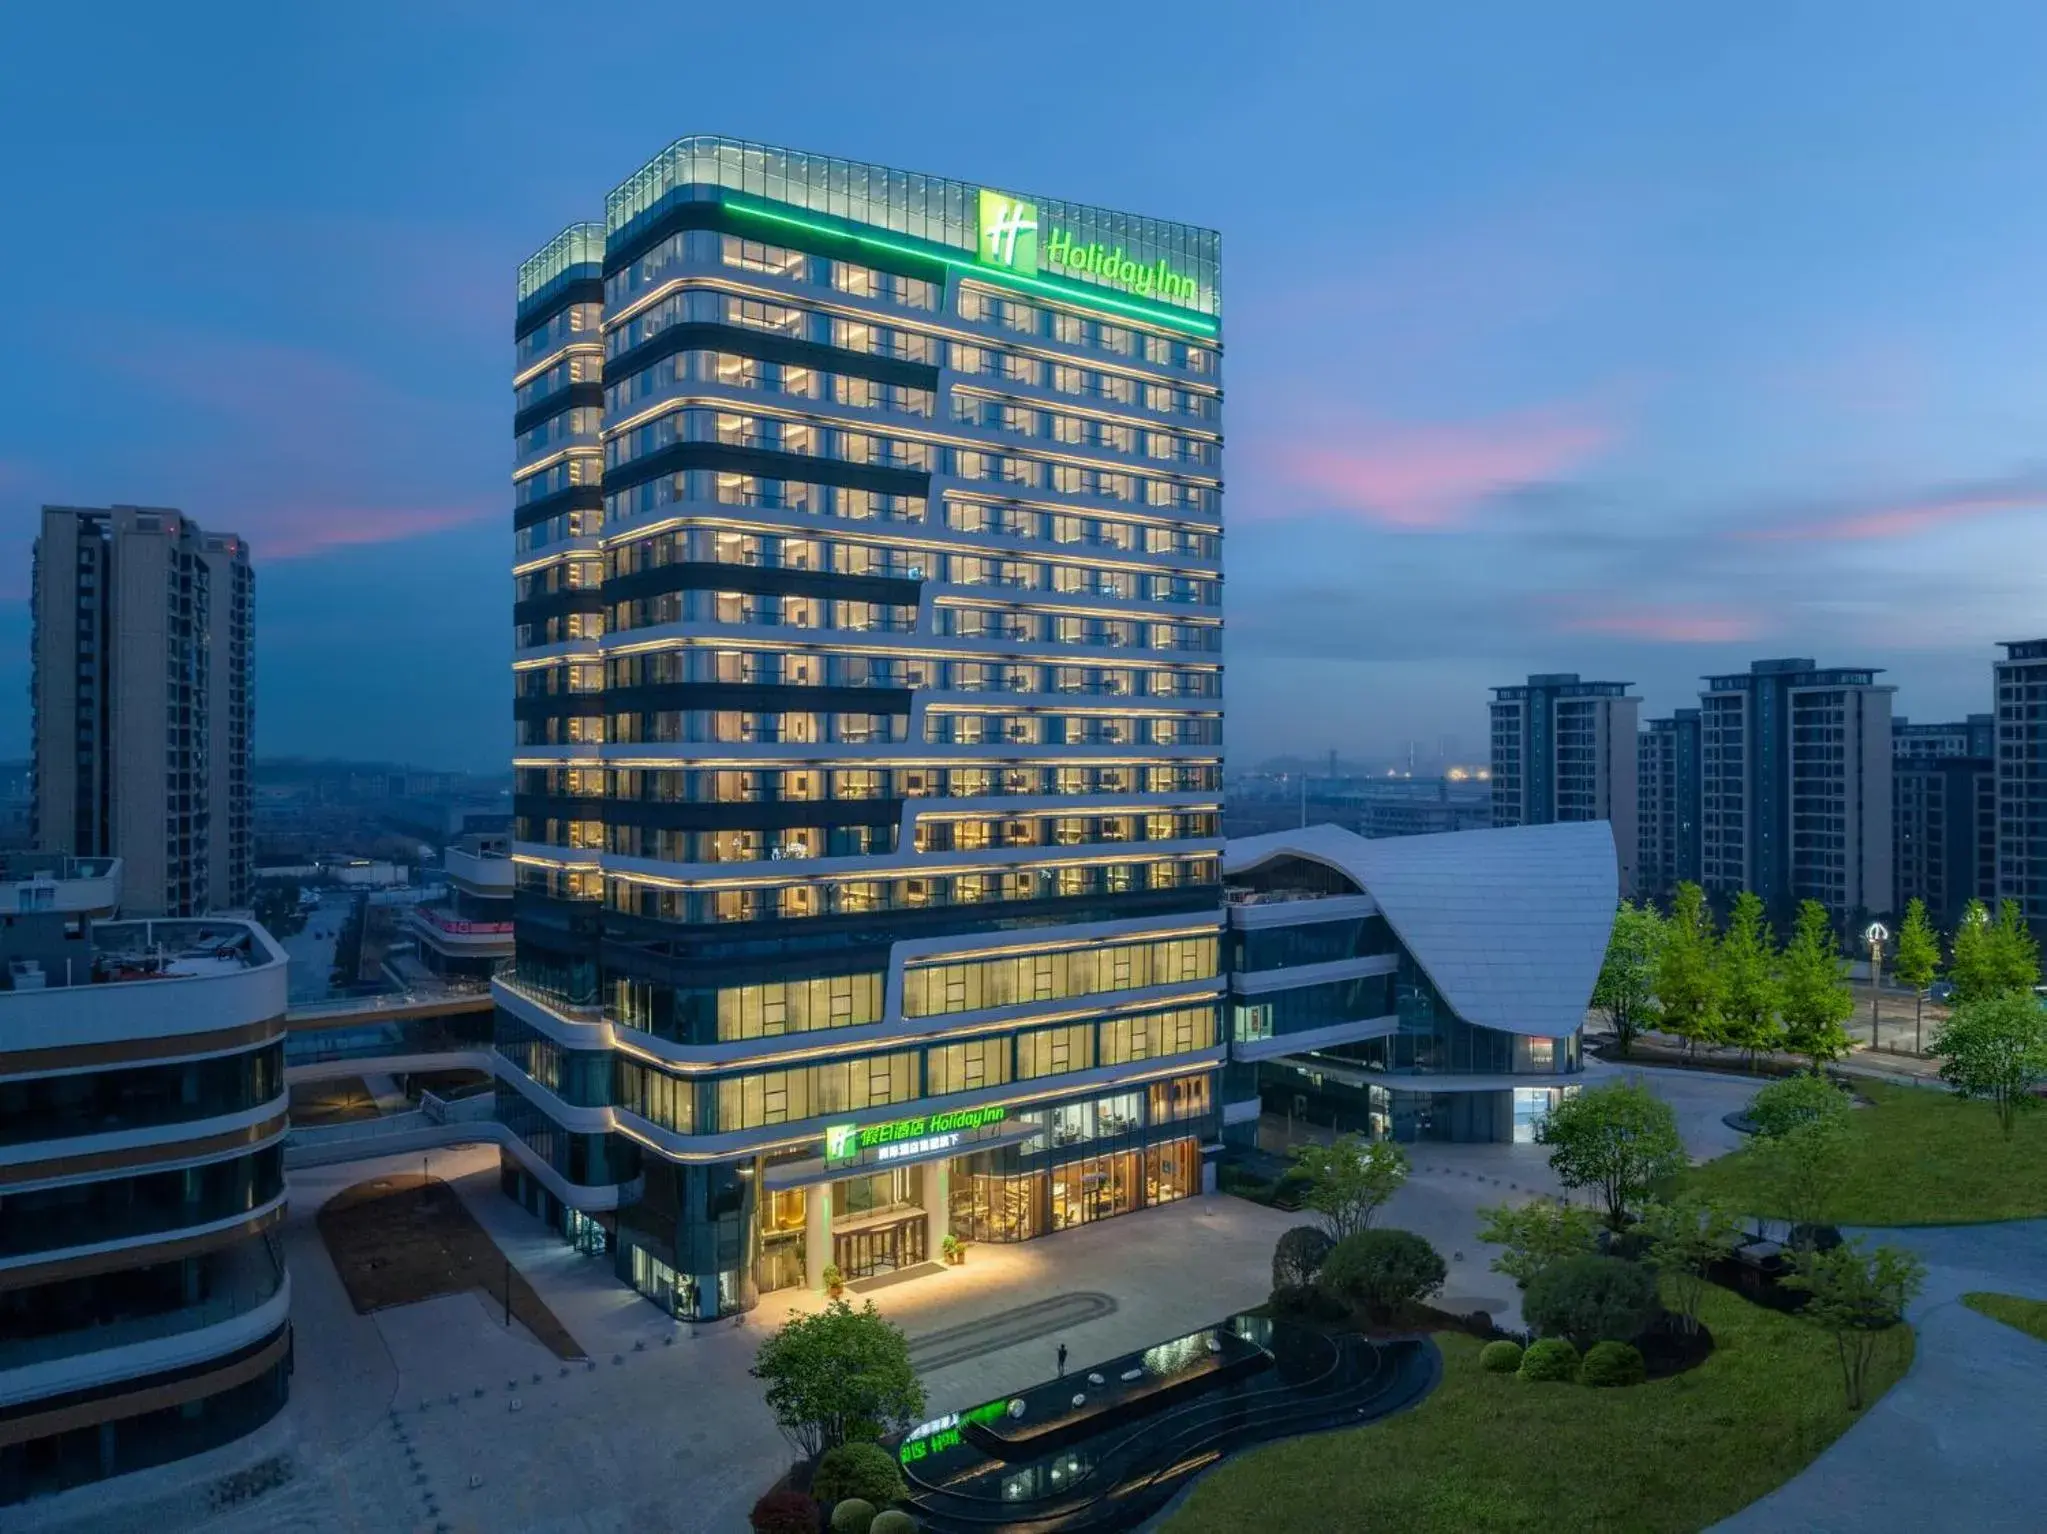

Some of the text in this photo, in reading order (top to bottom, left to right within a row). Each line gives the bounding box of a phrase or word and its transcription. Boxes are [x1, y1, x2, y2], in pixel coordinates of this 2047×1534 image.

[1047, 227, 1197, 299] Holiday Inn
[860, 1107, 1005, 1146] 假日酒店 Holiday Inn
